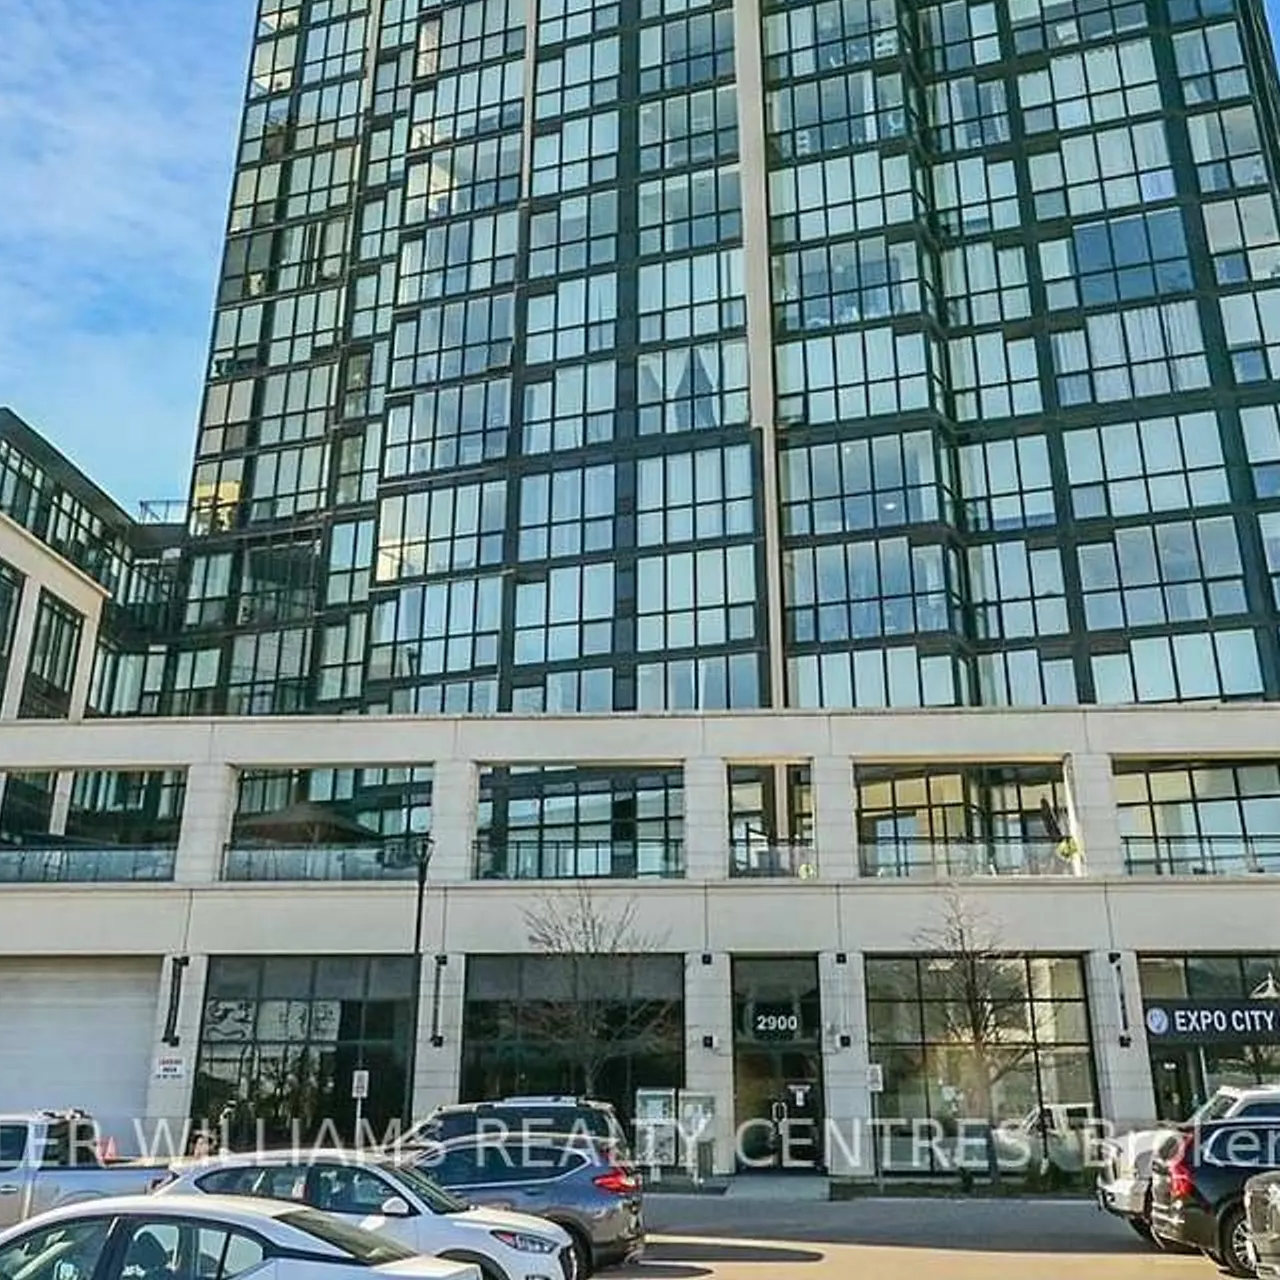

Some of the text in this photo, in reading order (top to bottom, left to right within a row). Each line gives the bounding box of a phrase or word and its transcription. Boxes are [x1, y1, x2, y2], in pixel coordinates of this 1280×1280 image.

[756, 1015, 798, 1031] 2900
[1175, 1010, 1227, 1032] EXPO
[1231, 1010, 1275, 1032] CITY
